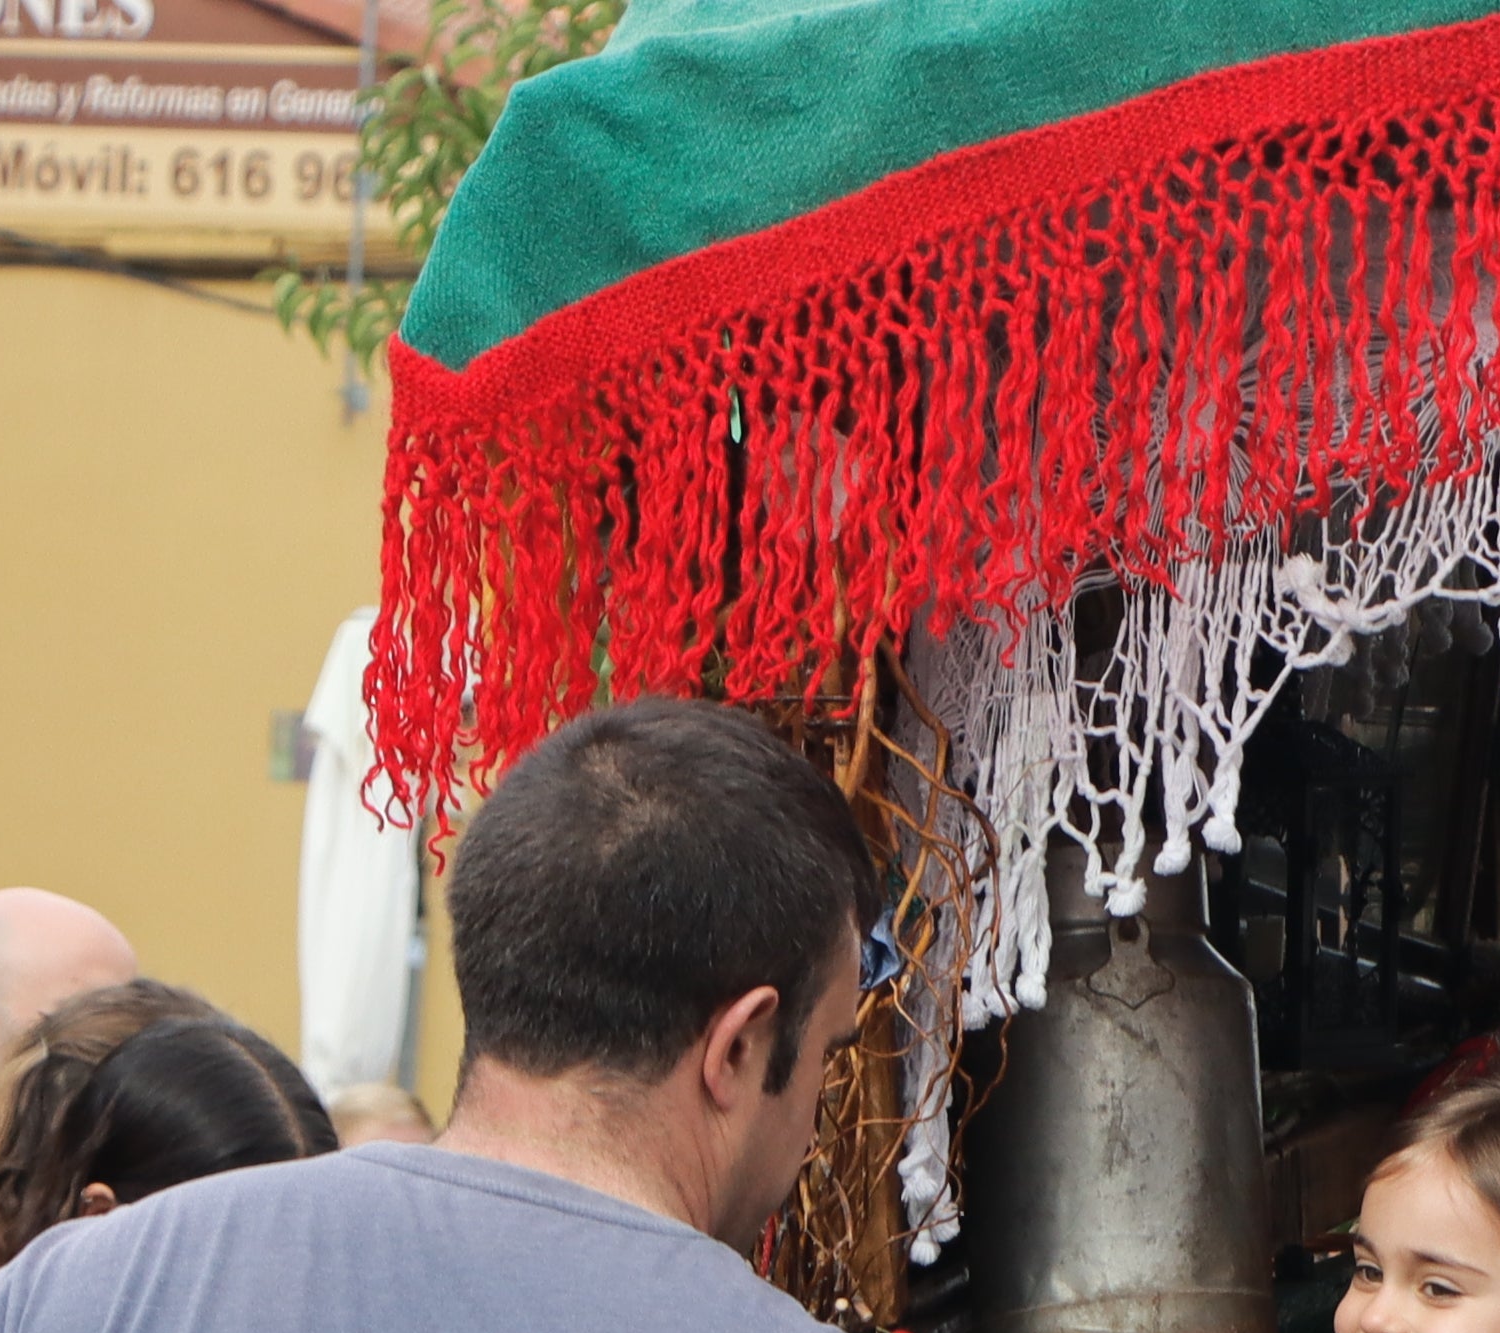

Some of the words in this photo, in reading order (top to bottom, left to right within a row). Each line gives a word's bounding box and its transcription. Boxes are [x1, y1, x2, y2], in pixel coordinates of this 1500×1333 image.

[82, 72, 226, 121] Reformas
[225, 86, 268, 124] en
[170, 146, 274, 200] 616
